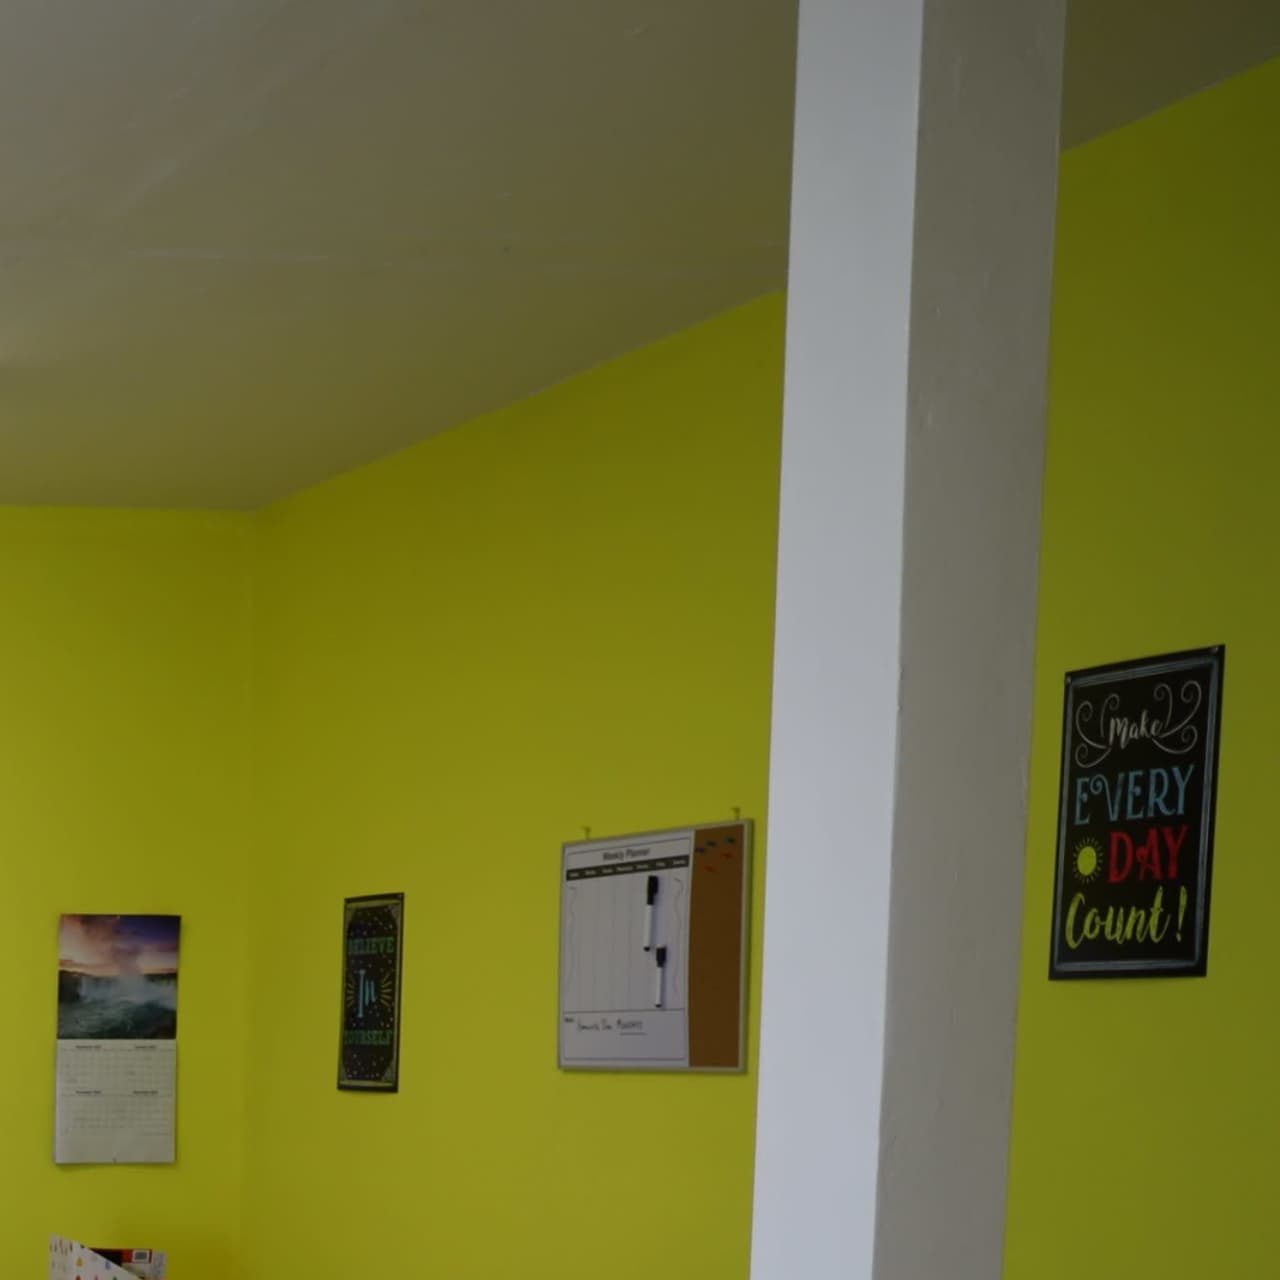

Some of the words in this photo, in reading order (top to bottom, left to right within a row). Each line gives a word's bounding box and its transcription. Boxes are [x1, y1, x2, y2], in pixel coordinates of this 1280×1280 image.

[1109, 710, 1163, 749] Make
[1074, 764, 1194, 825] EVERY
[1108, 825, 1187, 884] DAY
[347, 935, 395, 955] BELIEVE
[356, 968, 377, 1019] In
[344, 1029, 394, 1047] YOURSELF
